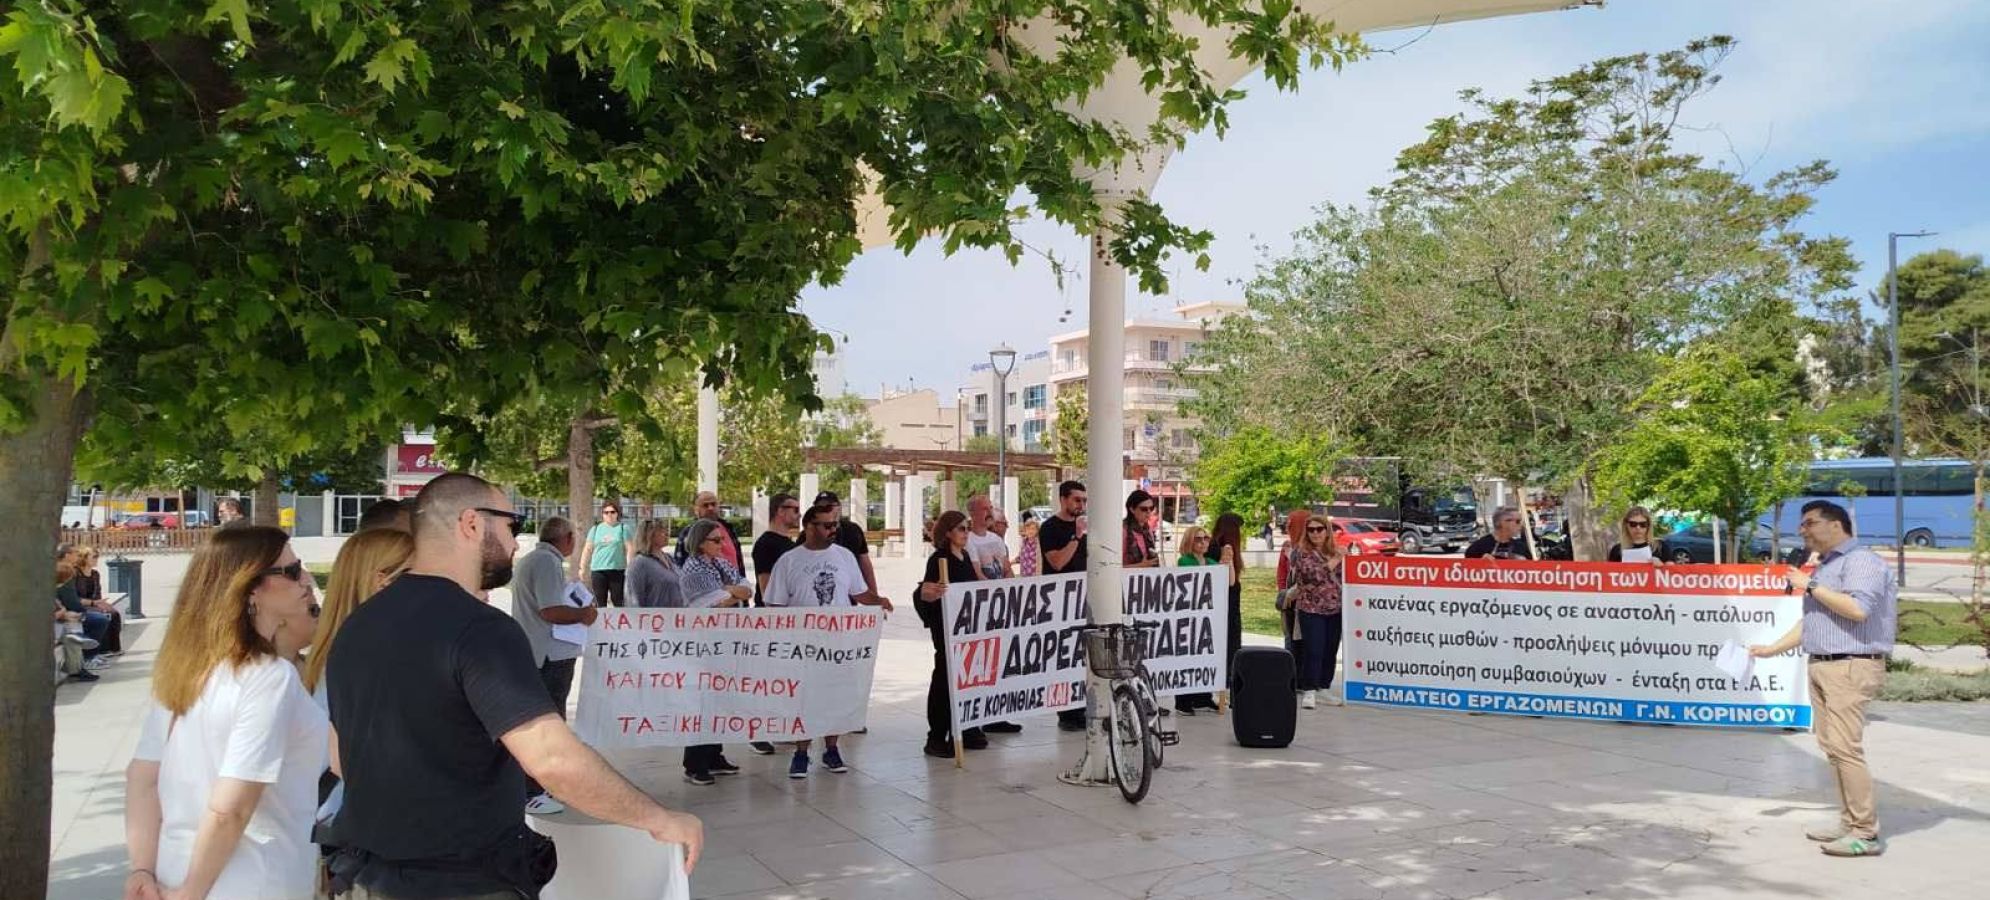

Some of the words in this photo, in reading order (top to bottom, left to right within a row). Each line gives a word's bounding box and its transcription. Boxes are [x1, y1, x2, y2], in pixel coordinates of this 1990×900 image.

[1356, 561, 1389, 580] ΟΧΙ
[1394, 564, 1438, 585] στην
[1444, 562, 1603, 591] ιδιωτικοποίηση
[1608, 571, 1649, 587] των
[1654, 568, 1789, 594] Νοσοκομείω
[953, 582, 1056, 635] ΑΓΩΝΑΣ
[1121, 572, 1214, 614] ΗΜΟΣΙΑ
[1368, 594, 1435, 615] κανένας
[1440, 597, 1552, 620] εργαζόμενος
[1557, 606, 1579, 619] σε
[1584, 603, 1676, 625] αναστολή
[1693, 604, 1775, 628] απόλυση
[804, 613, 877, 632] ΠΟΛΙΤΙΚΗ
[594, 641, 631, 659] ΤΗΣ
[638, 638, 724, 660] ΦΤΩΧΕΙΑΣ
[954, 639, 999, 687] ΚΑΙ
[1001, 629, 1087, 679] ΔΩΡΕΑ
[1366, 626, 1435, 647] αυξήσεις
[1439, 629, 1498, 648] μισθών
[1513, 632, 1615, 657] προσλήψεις
[1620, 637, 1692, 659] μόνιμου
[606, 671, 643, 689] ΚΑΙ
[650, 672, 686, 690] ΤΟΥ
[698, 672, 800, 697] ΠΟΛΕΜΟΥ
[1367, 659, 1476, 682] μονιμοποίηση
[1481, 663, 1607, 688] συμβασιούχων
[1632, 669, 1690, 693] ένταξη
[1696, 677, 1726, 691] στα
[984, 687, 1045, 718] ΚΟΡΙΝΘΙΑΣ
[1363, 686, 1461, 707] ΣΩΜΑΤΕΙΟ
[1468, 692, 1623, 717] ΕΡΓΑΖΟΜΕΝΩΝ
[1636, 704, 1676, 719] Γ.Ν.
[1683, 705, 1796, 723] ΚΟΡΙΝΘΟΥ
[618, 715, 701, 734] ΤΑΞΙΚΗ
[713, 715, 805, 739] ΠΟΡΕΙΑ
